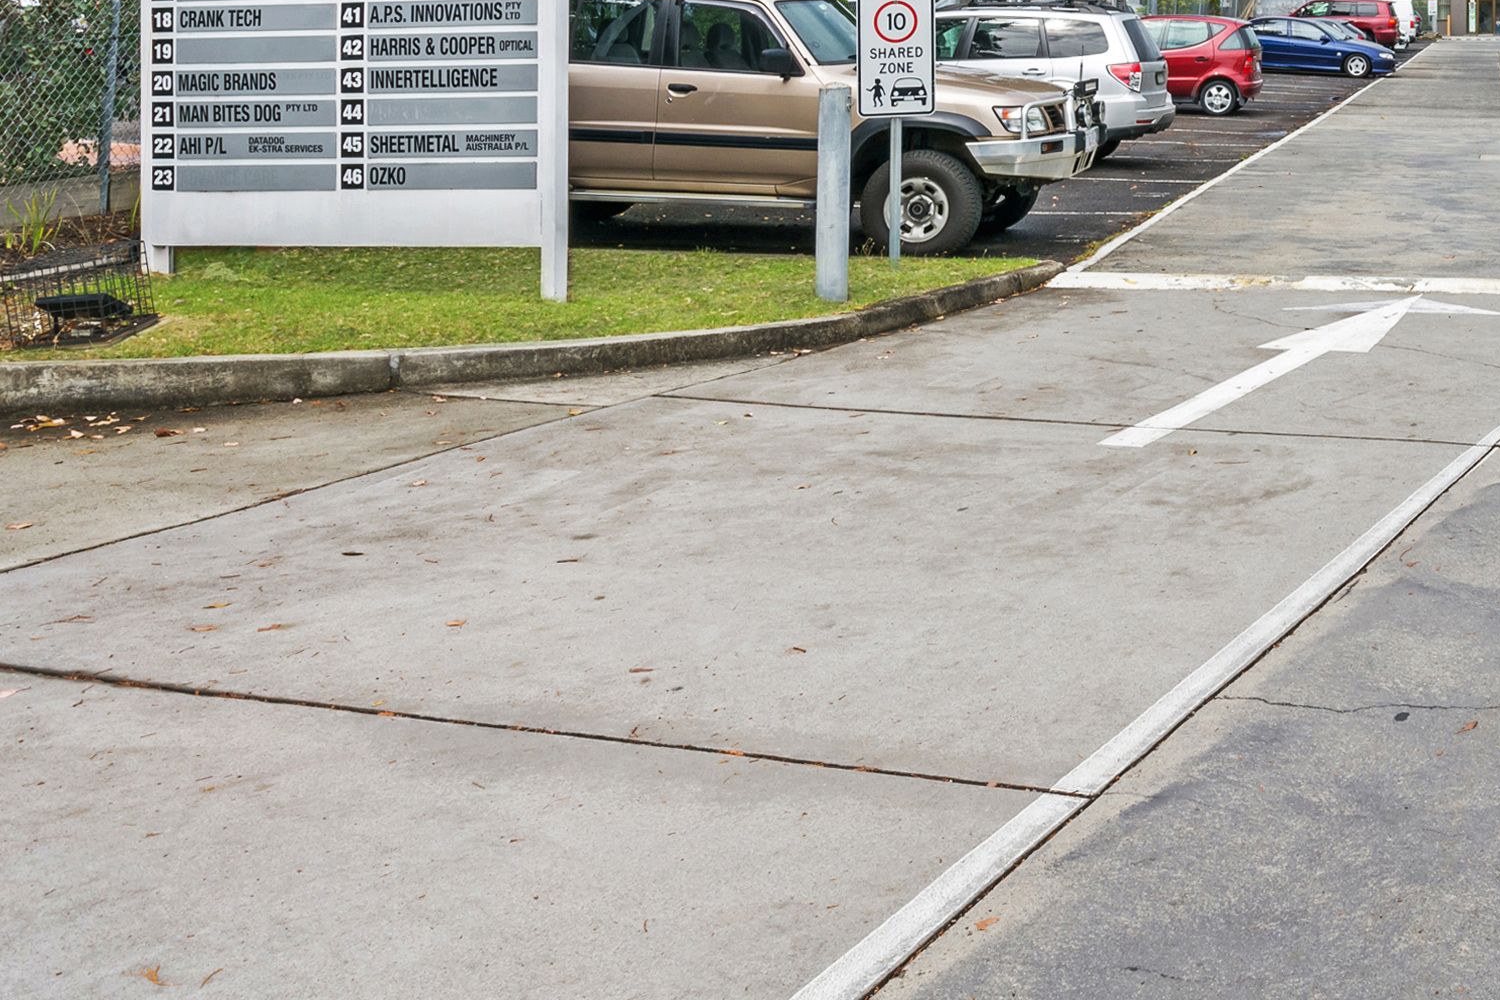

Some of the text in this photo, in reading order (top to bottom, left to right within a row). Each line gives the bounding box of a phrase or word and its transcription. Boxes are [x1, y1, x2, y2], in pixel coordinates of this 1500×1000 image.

[370, 2, 502, 23] A.P.S. INNOVATIONS
[505, 2, 521, 10] PTY
[180, 9, 261, 28] CRANK TECH
[505, 12, 520, 20] LTD
[887, 13, 906, 30] 10
[371, 36, 533, 56] HARRIS & COOPER OPTICAL
[870, 47, 923, 59] SHARED
[879, 62, 914, 74] ZONE
[178, 73, 219, 91] MAGIC
[224, 72, 276, 90] BRANDS
[371, 68, 498, 89] INNERTELLIGENCE
[179, 104, 318, 122] MAN BITES DOG PTY LTD
[179, 137, 227, 155] AHI P/L
[249, 137, 284, 145] DATADOG
[371, 135, 459, 153] SHEETMETAL
[466, 134, 516, 142] MACHINERY
[466, 142, 528, 151] AUSTRALIA P/L
[285, 145, 323, 153] SERVICES
[370, 167, 406, 185] OZKO
